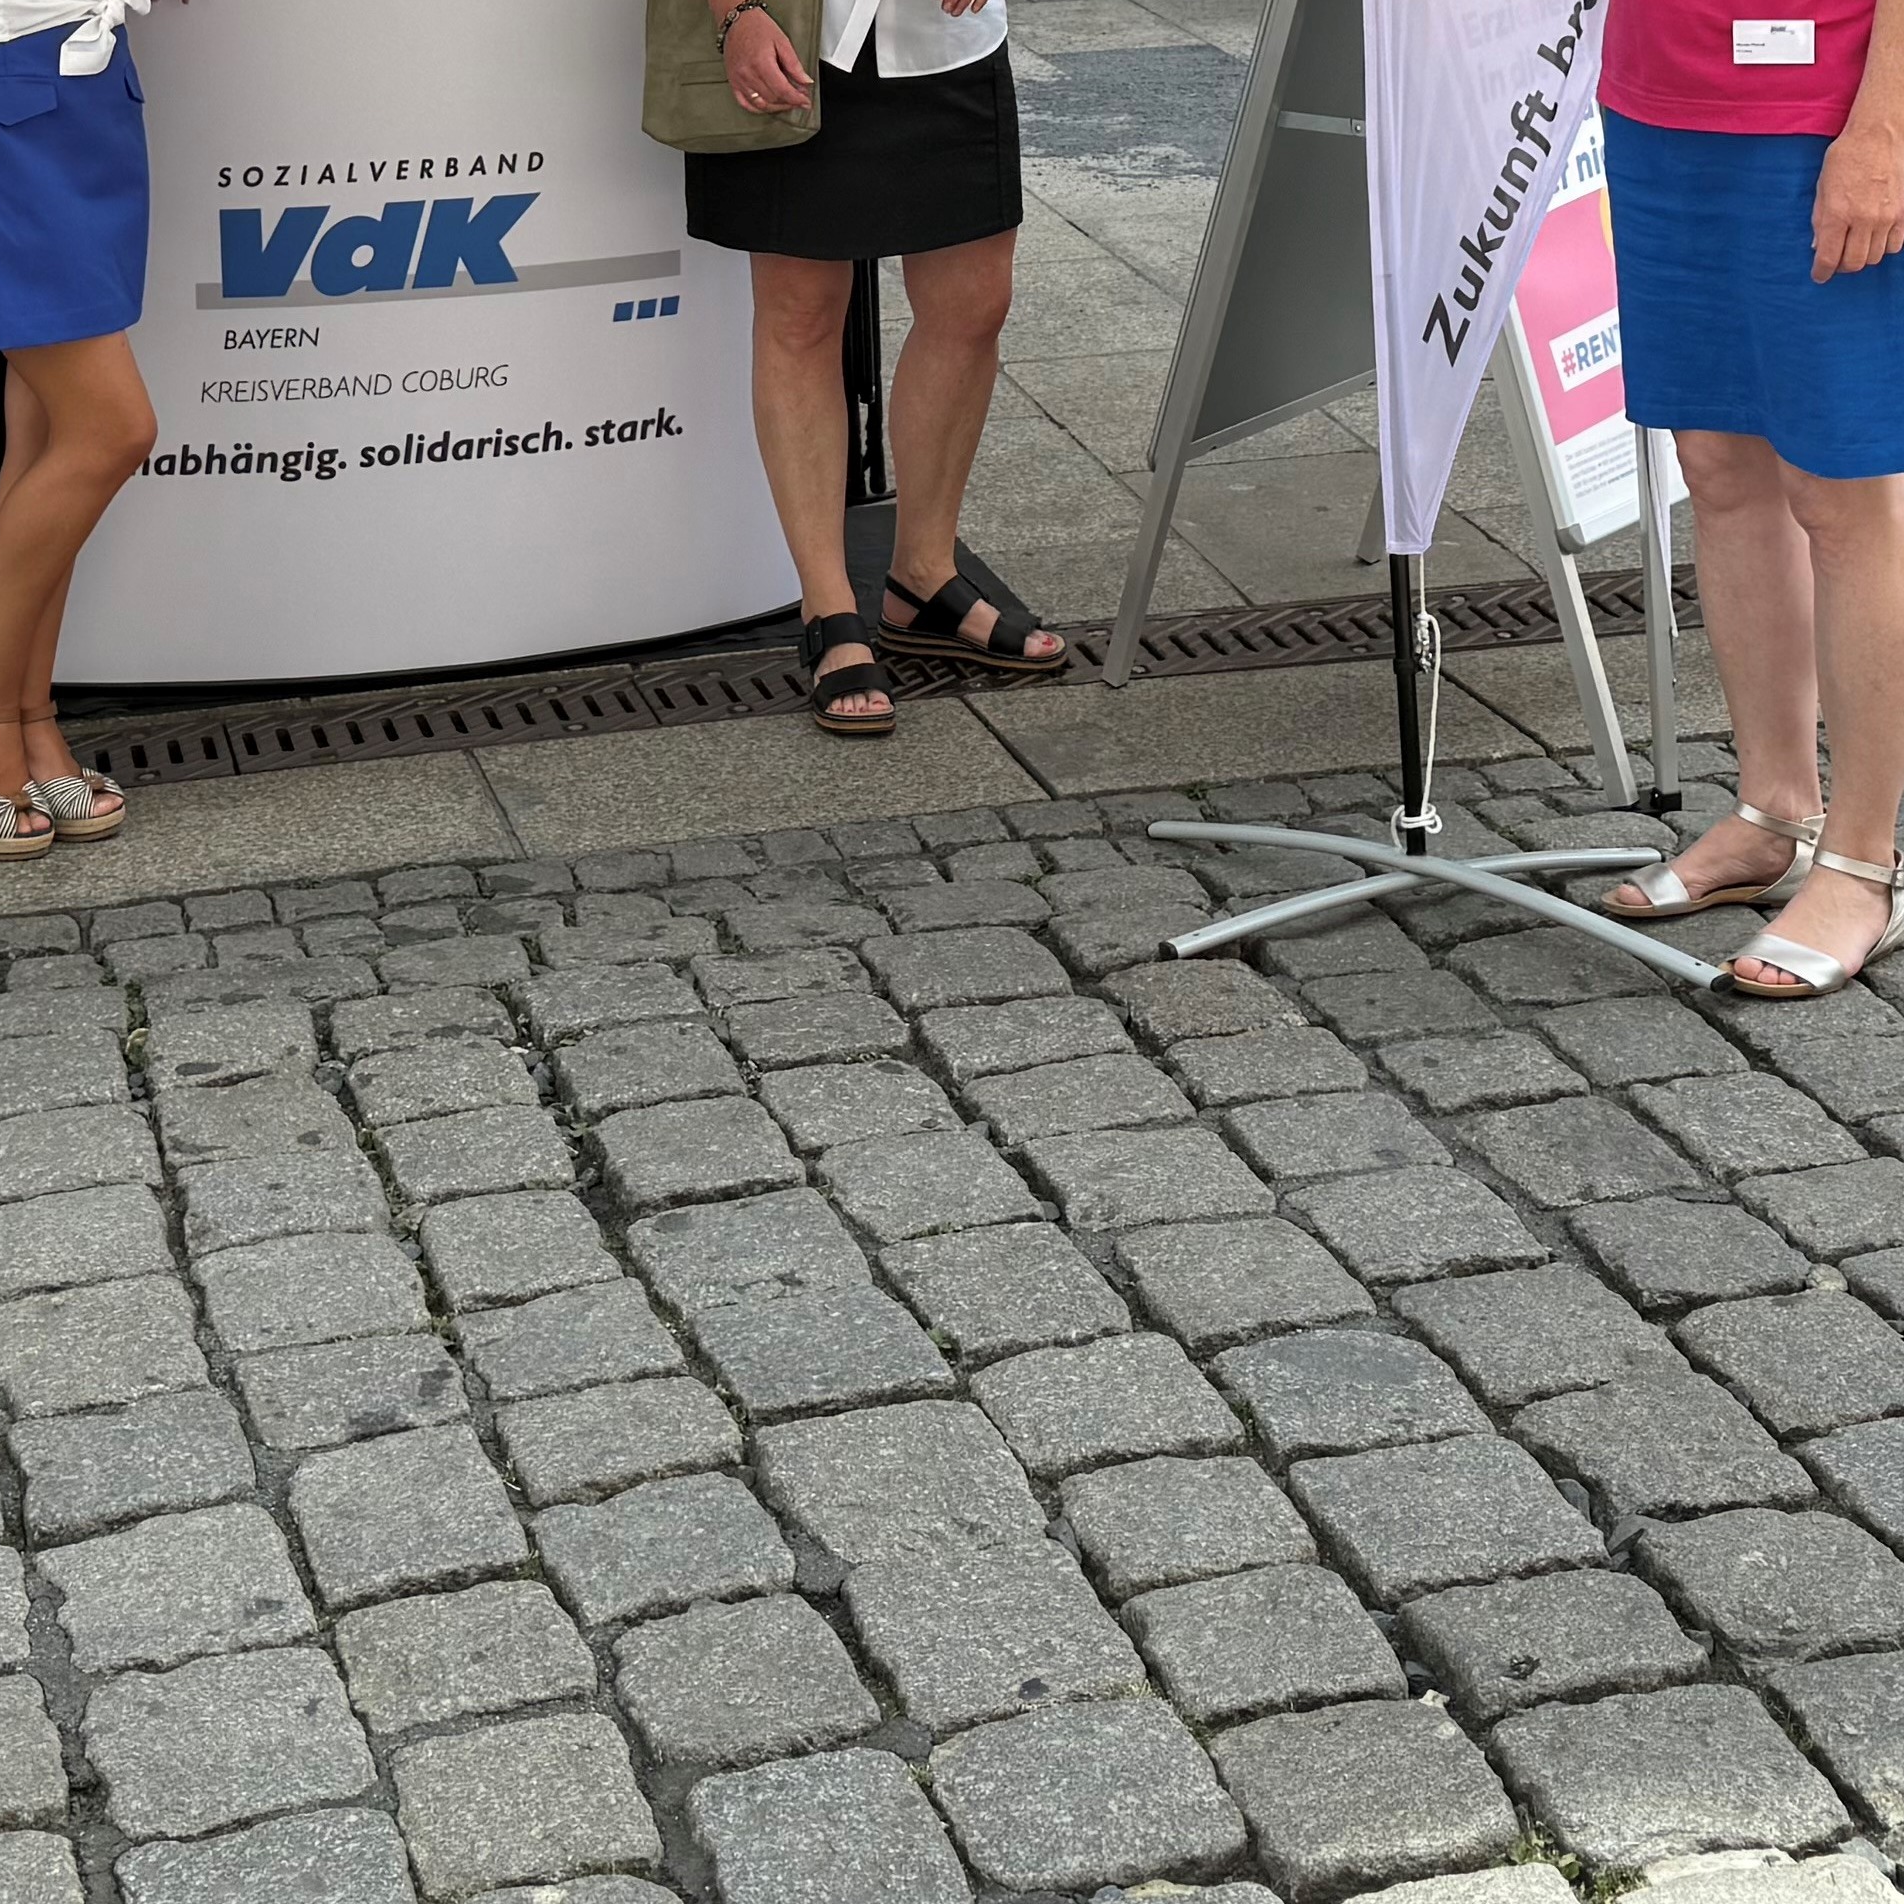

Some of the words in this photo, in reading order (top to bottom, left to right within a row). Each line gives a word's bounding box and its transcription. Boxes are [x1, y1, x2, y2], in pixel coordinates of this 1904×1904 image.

[217, 151, 547, 188] SOZIALVERBAND
[218, 192, 541, 299] VdK
[1422, 89, 1558, 368] Zukunft
[223, 327, 320, 350] BAYERN
[200, 374, 392, 404] KREISVERBAND
[402, 364, 509, 394] COBURG
[360, 422, 574, 469] solidarisch.
[585, 408, 684, 449] stark.
